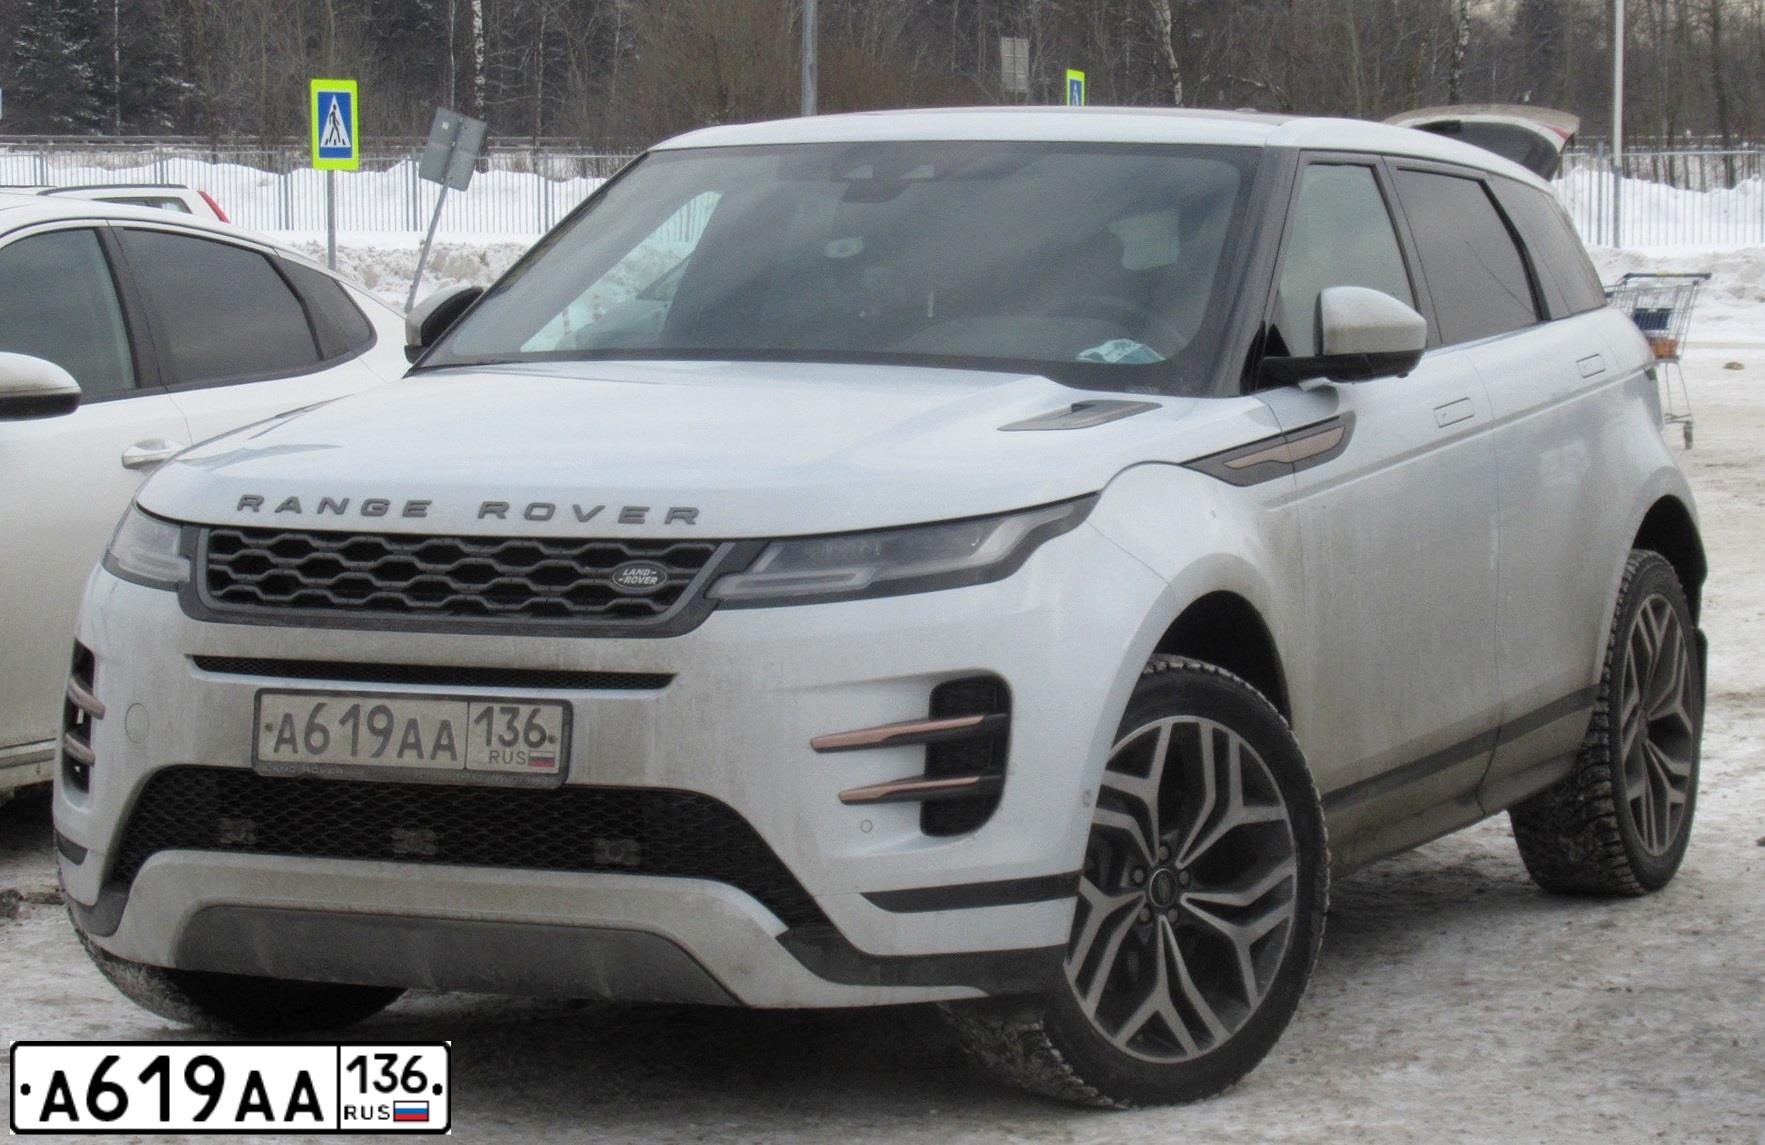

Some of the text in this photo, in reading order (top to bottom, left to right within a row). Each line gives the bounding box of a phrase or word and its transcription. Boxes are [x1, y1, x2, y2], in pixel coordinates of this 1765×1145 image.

[236, 494, 700, 525] RANGE ROVER
[273, 702, 546, 761] A619AA 136
[488, 750, 527, 766] RUS
